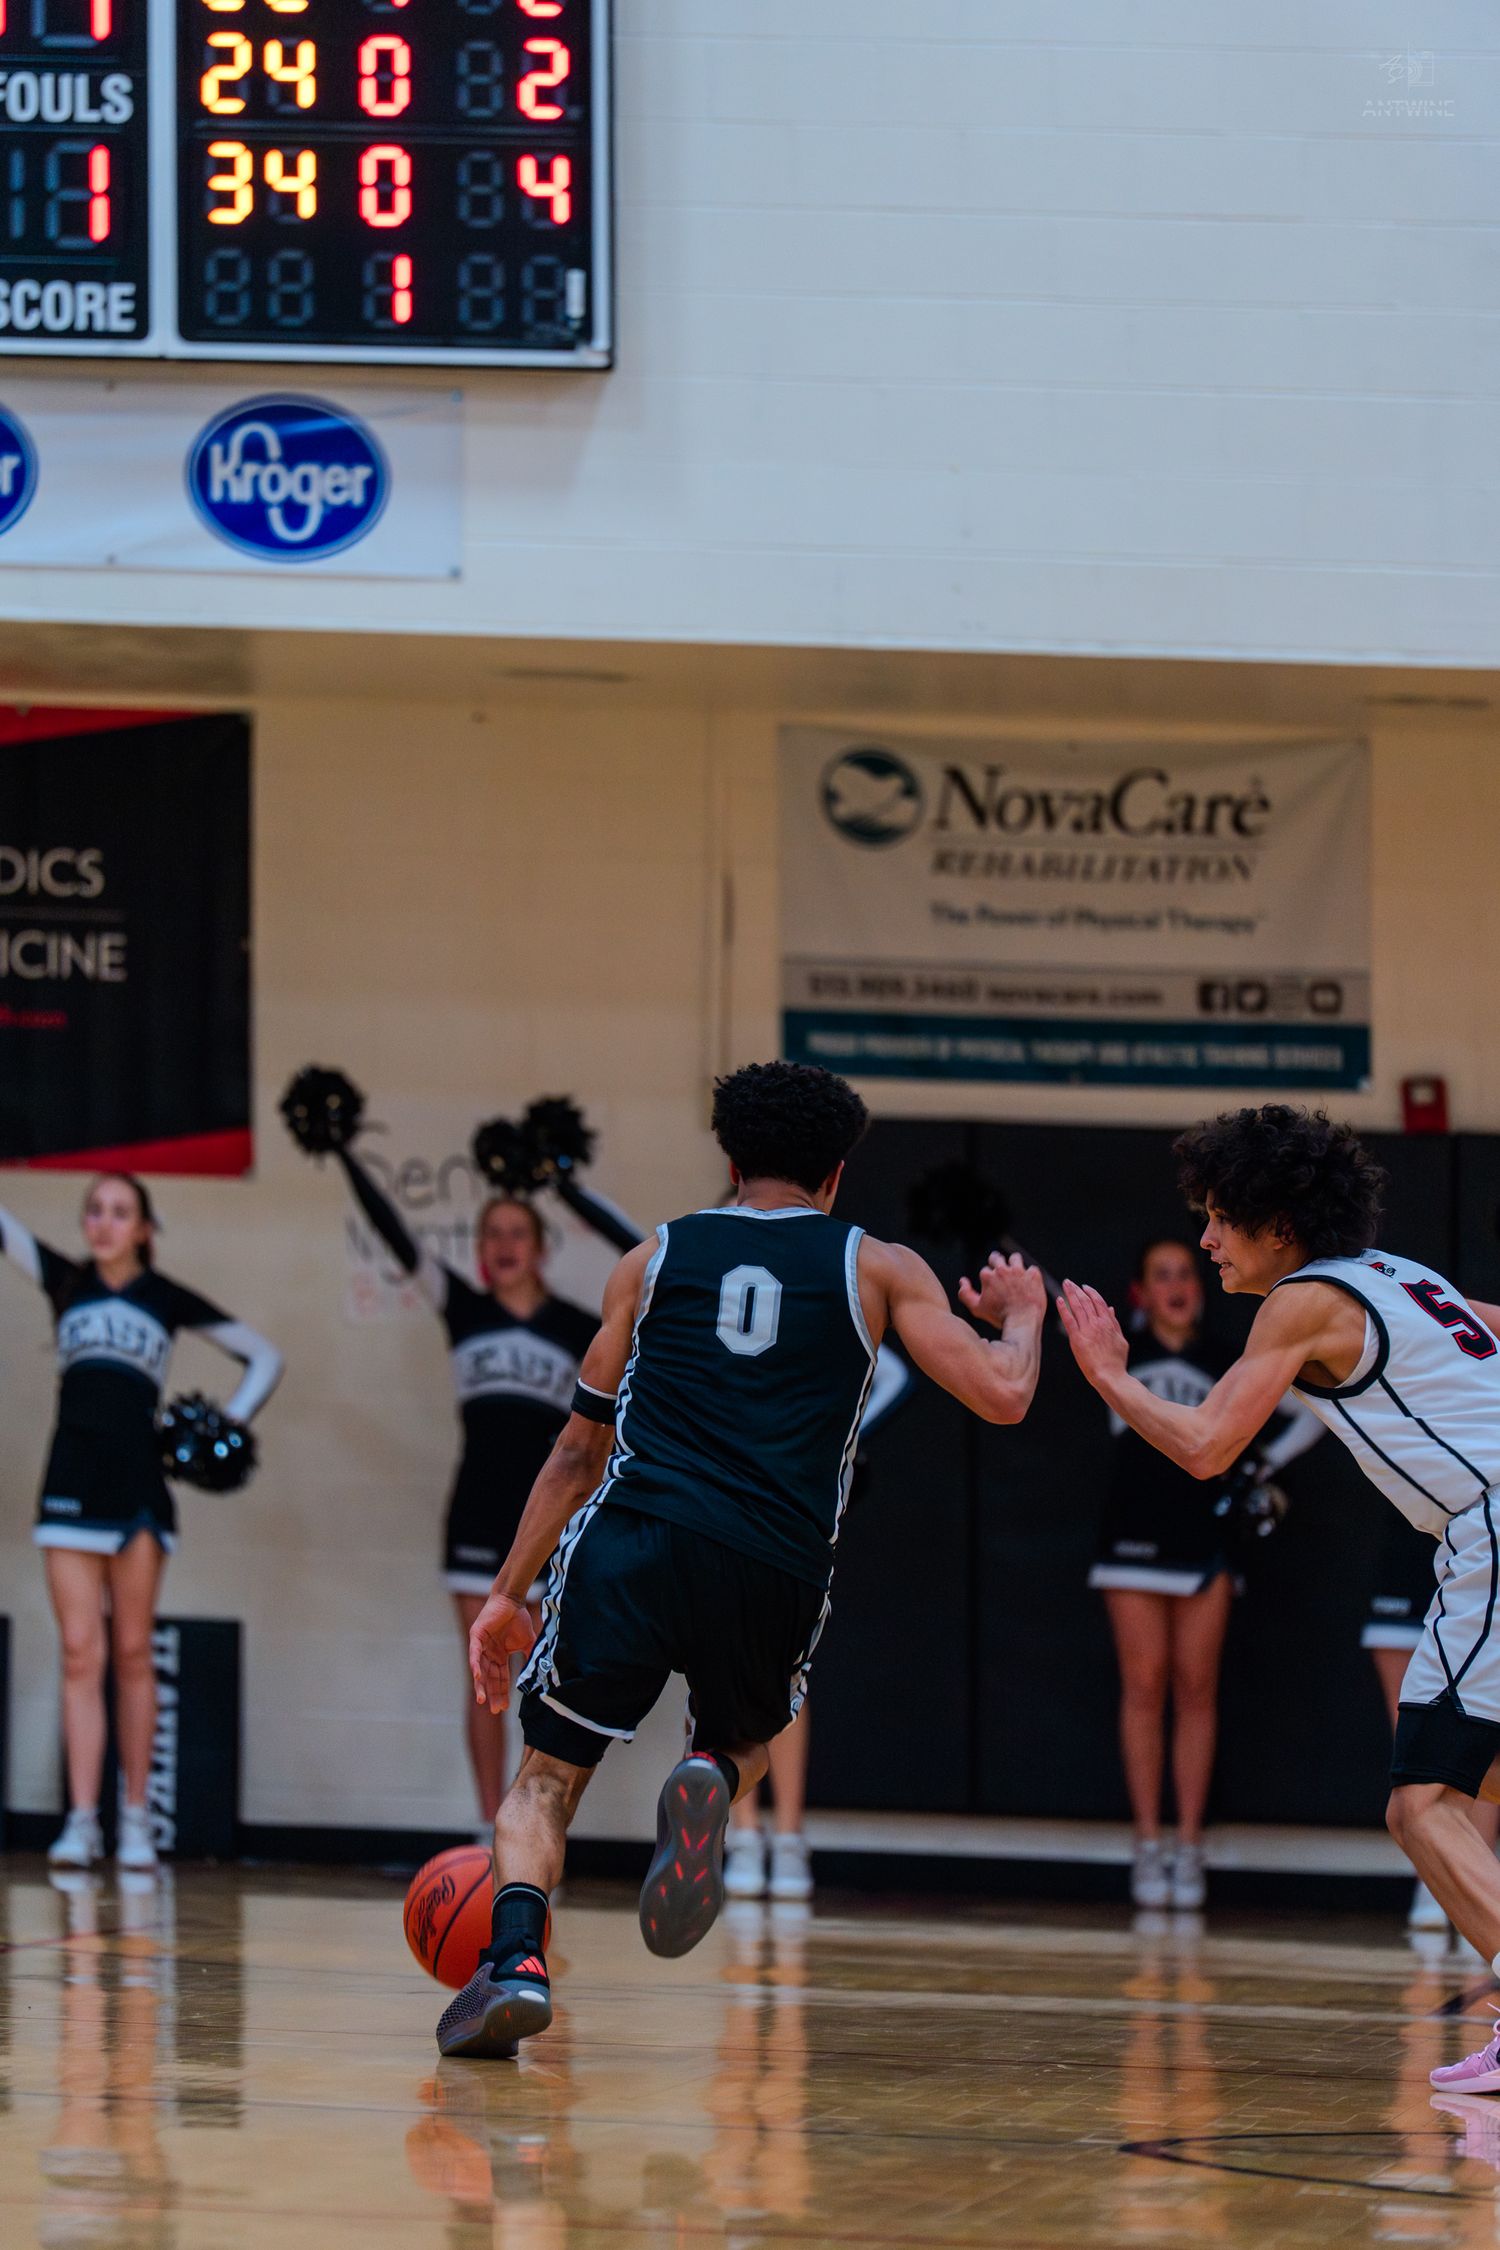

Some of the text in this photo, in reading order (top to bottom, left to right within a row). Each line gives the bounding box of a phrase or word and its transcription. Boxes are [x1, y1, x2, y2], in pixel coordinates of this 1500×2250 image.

[201, 31, 571, 120] 24 0 2
[88, 144, 111, 242] 1
[207, 141, 571, 228] 34 0 4
[391, 253, 413, 323] 1
[208, 421, 373, 542] Kroger
[934, 762, 1272, 838] NovaCare
[716, 1264, 783, 1357] 0
[1399, 1279, 1498, 1361] 5
